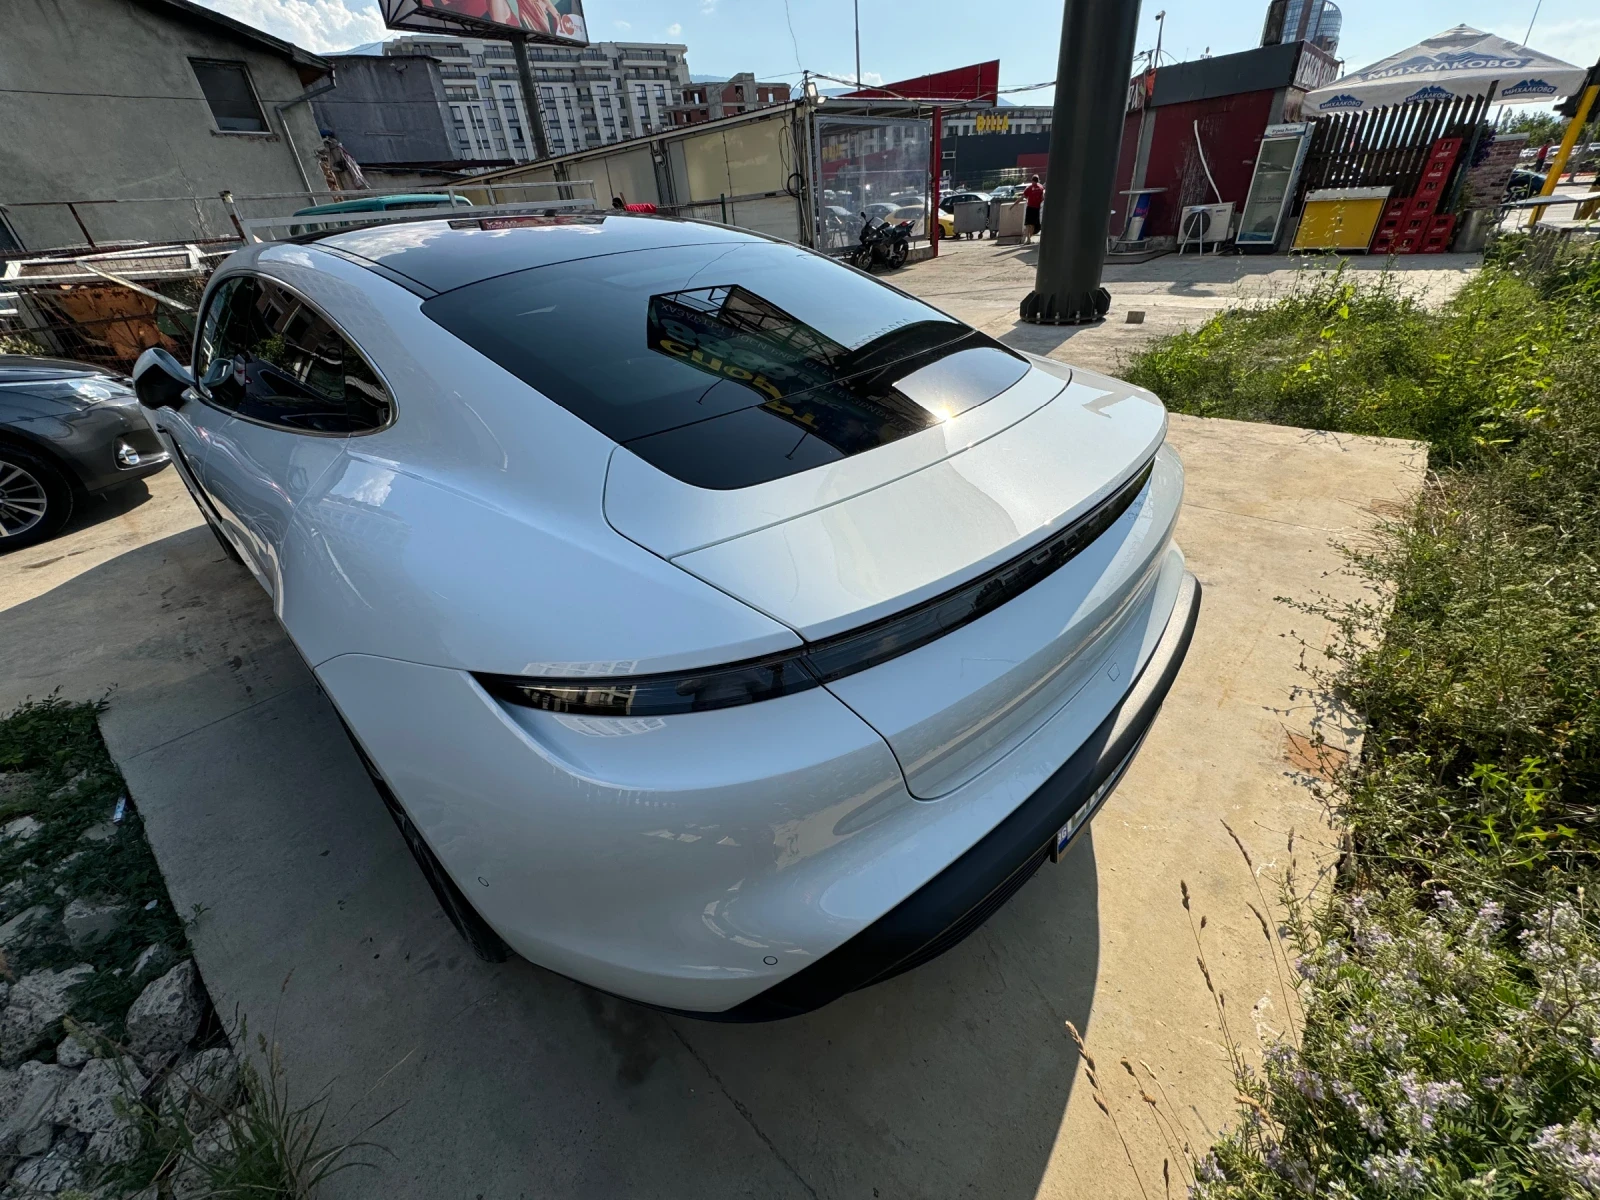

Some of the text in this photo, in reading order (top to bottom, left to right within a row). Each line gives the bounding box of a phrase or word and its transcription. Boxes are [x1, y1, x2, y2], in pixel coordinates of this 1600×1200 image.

[1367, 58, 1524, 80] МИХАЛКОВО
[1504, 85, 1555, 96] МИХАЛКОВО
[1320, 99, 1362, 109] МИХАЛКОВО
[976, 115, 1008, 130] BILLA
